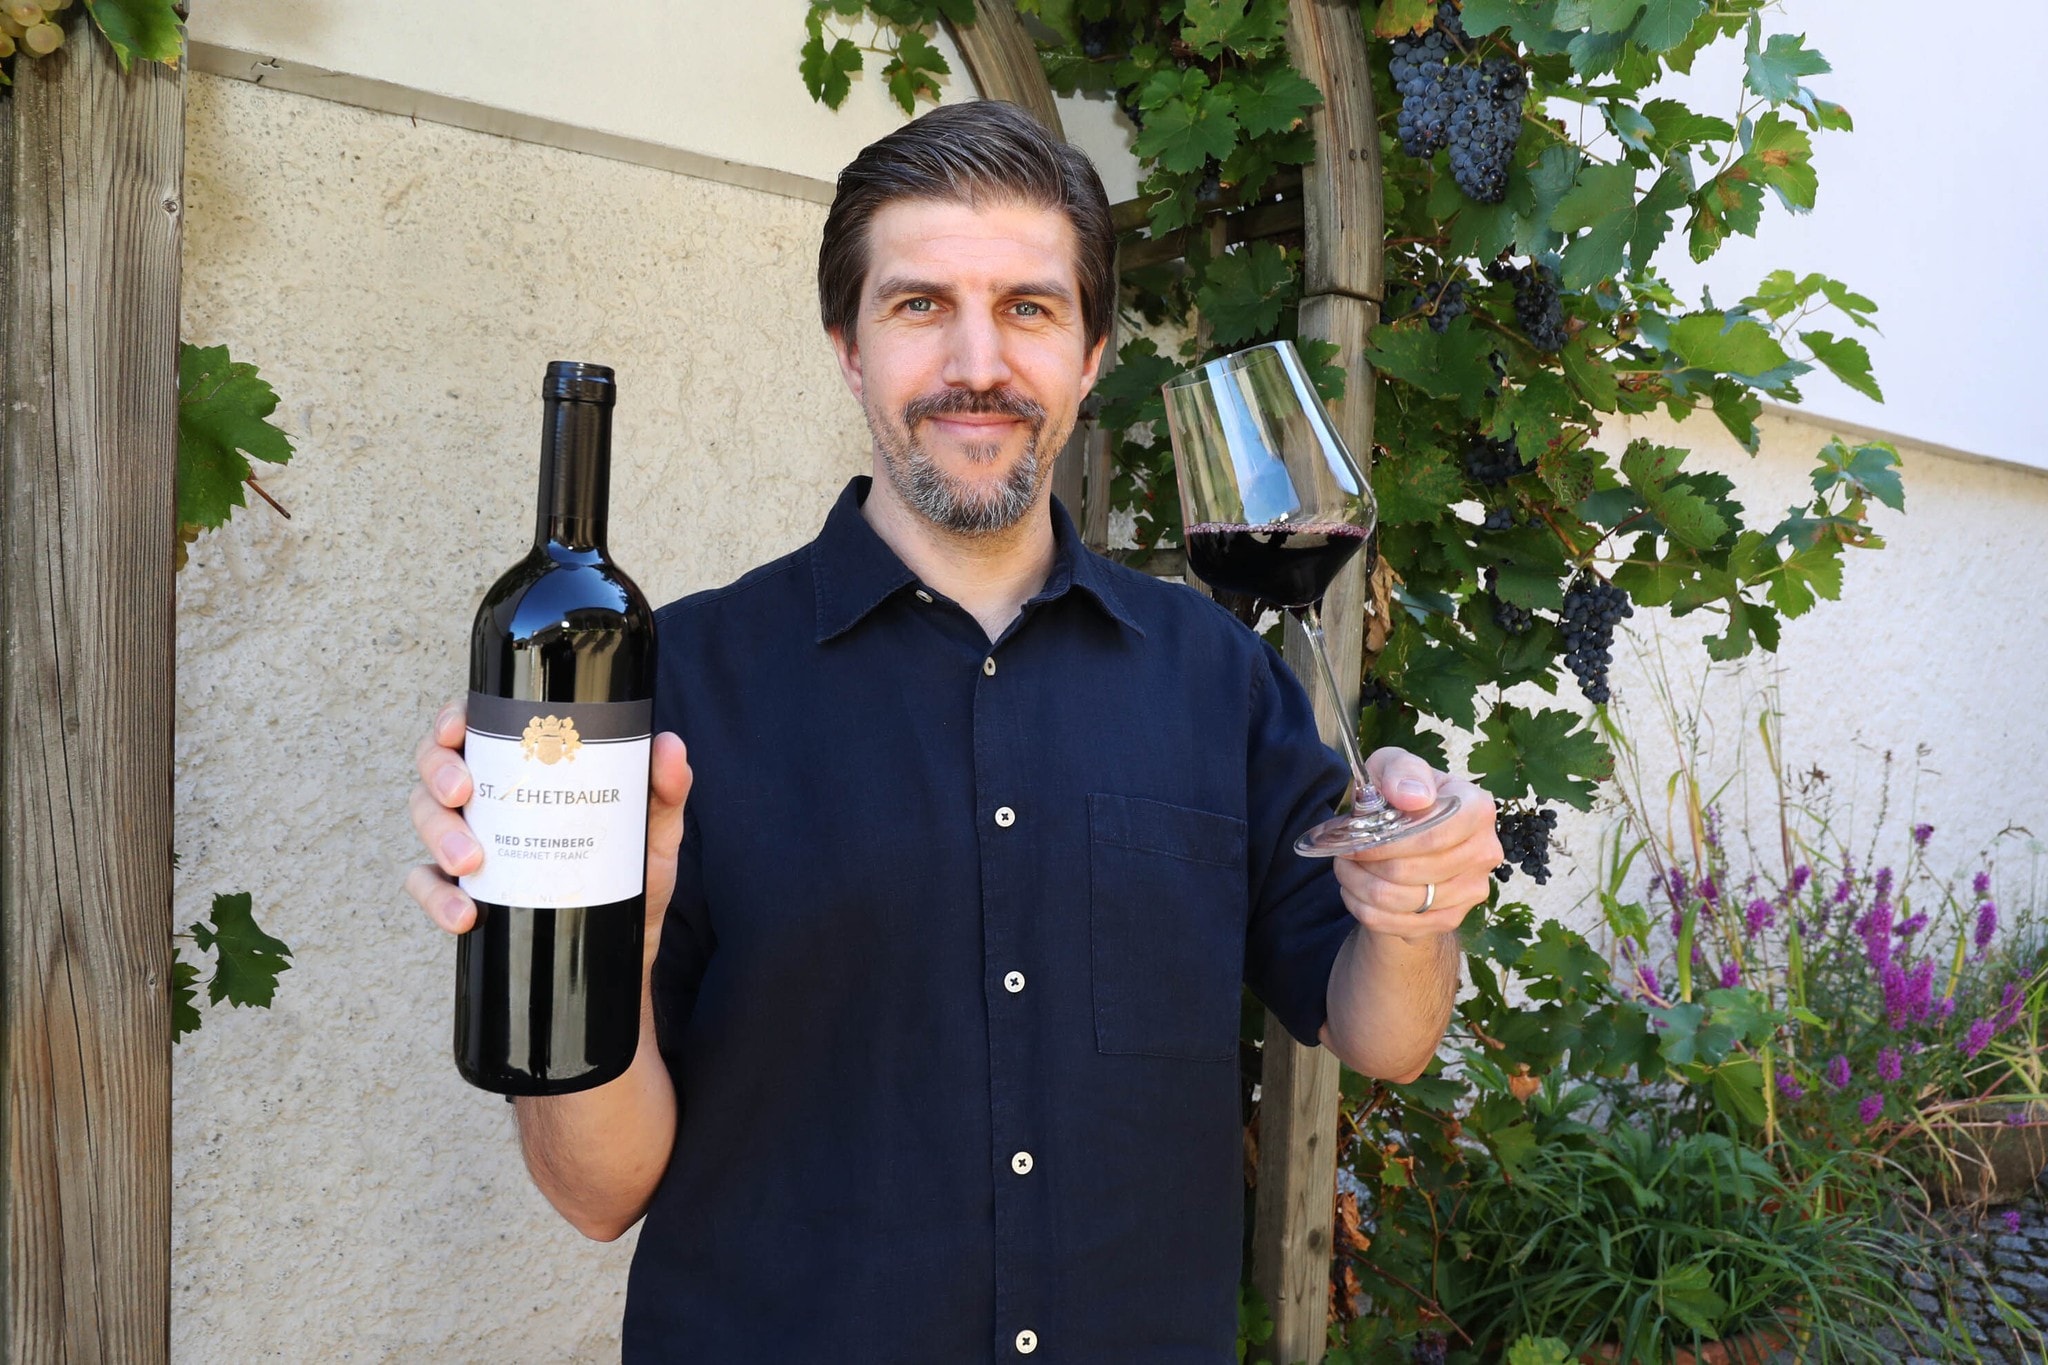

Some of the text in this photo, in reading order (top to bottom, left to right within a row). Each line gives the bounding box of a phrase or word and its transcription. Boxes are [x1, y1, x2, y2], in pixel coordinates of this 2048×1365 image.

[479, 782, 497, 800] ST.
[495, 834, 594, 848] RIED STEINBERG
[498, 848, 589, 860] CABERNET FRANC
